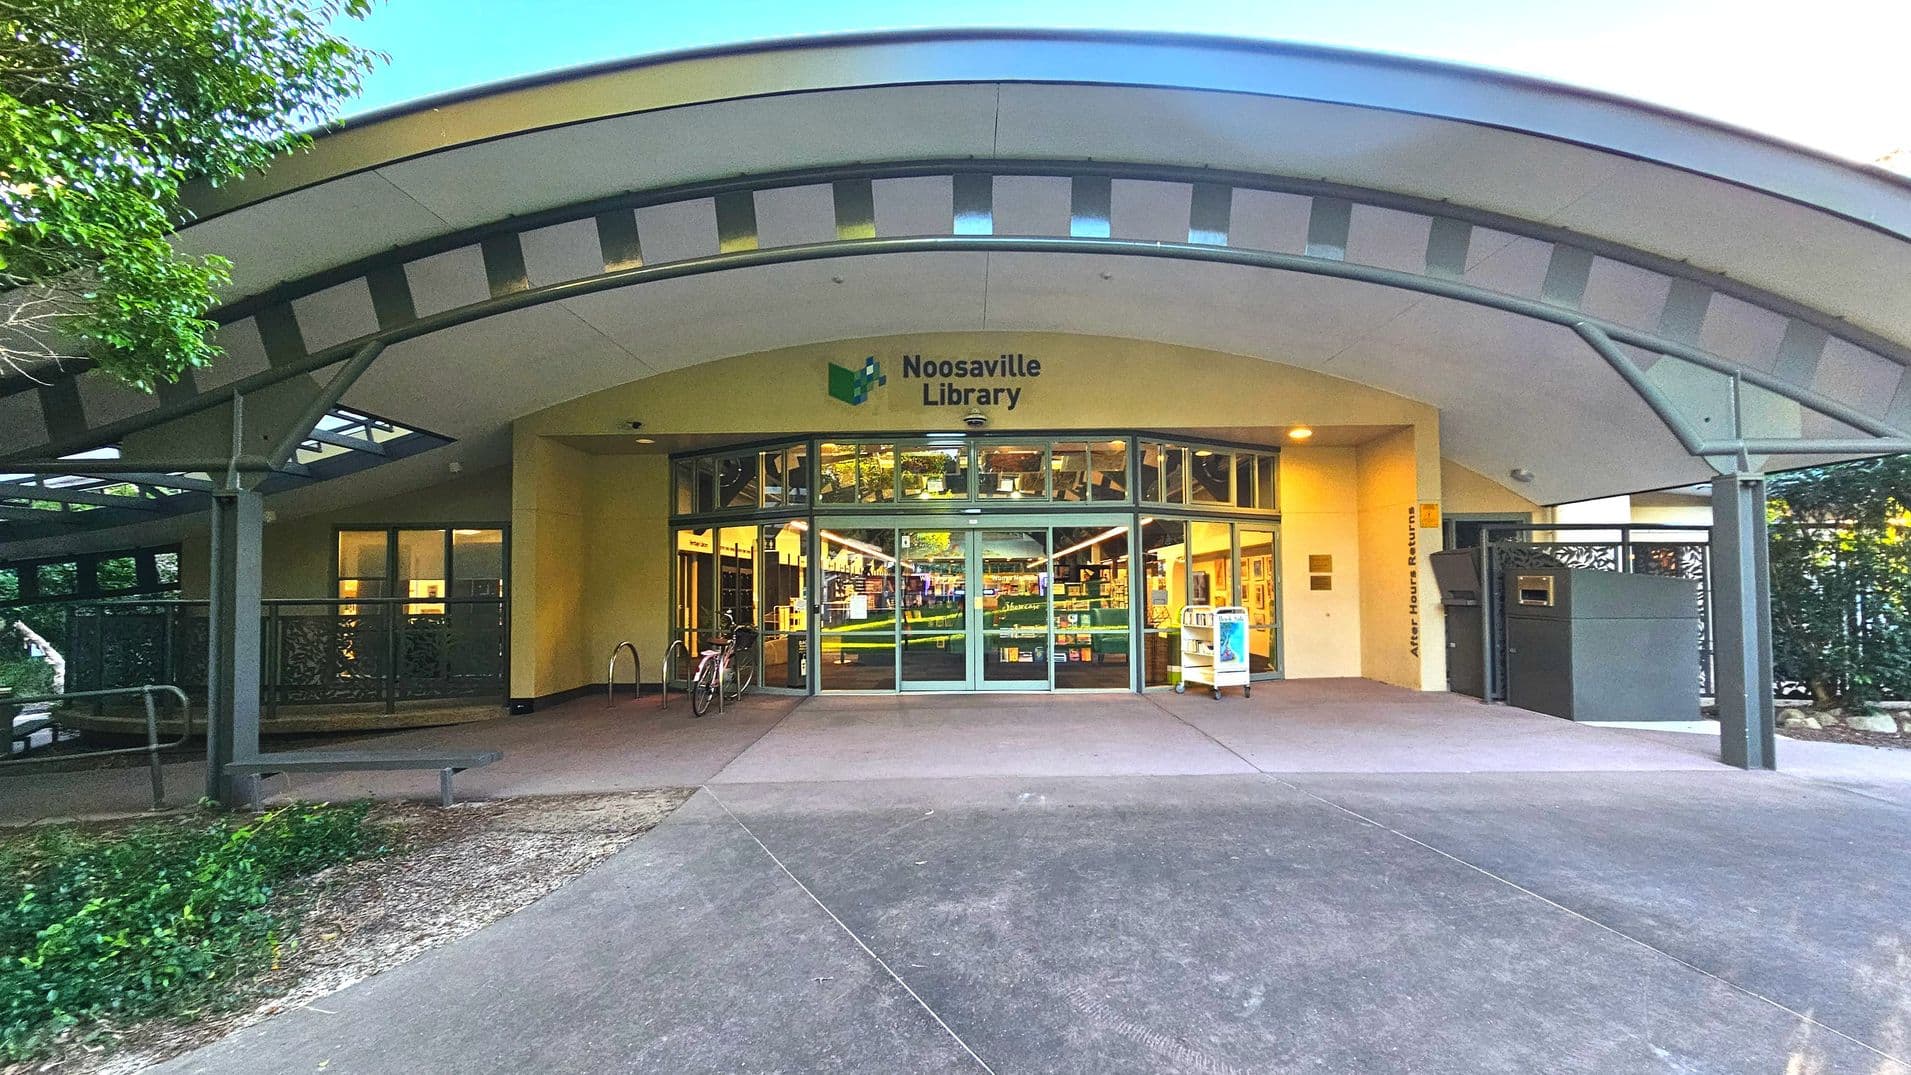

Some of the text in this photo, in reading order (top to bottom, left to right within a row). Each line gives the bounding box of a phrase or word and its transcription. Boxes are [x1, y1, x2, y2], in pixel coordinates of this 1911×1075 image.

[903, 354, 1041, 378] Noosaville
[923, 383, 1021, 410] Library
[1408, 507, 1419, 657] After Hours Returns
